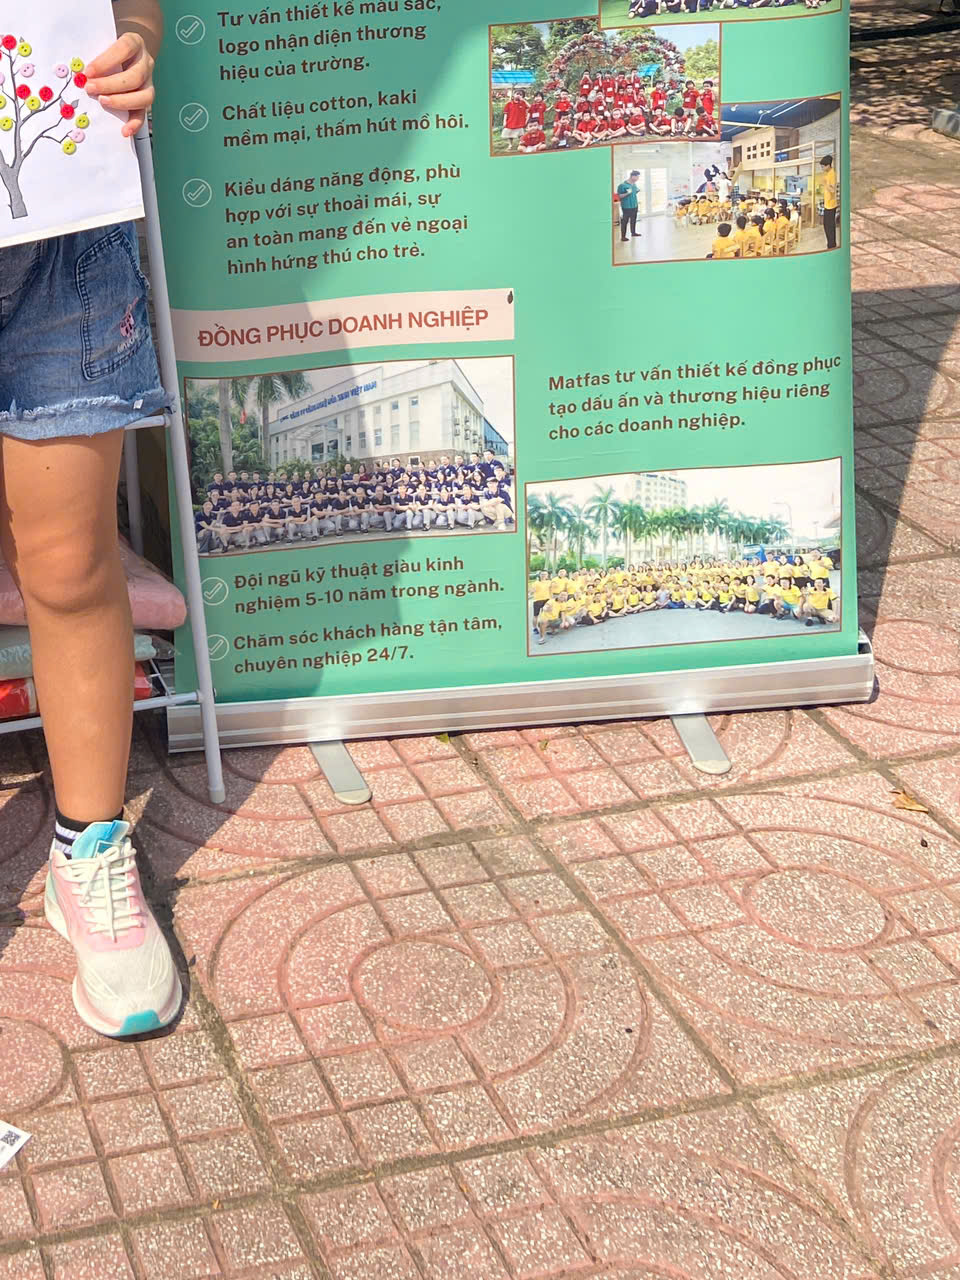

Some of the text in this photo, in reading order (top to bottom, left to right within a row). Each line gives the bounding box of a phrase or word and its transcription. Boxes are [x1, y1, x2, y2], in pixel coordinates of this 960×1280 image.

[217, 11, 244, 27] Tư
[248, 6, 281, 25] vấn
[285, 1, 329, 22] thiết
[219, 21, 427, 56] logo nhận diện thương
[197, 305, 488, 347] ĐỒNG PHỤC DOANH NGHIỆP
[549, 356, 841, 391] Matfas tư vấn thiết kế đồng phục
[548, 383, 830, 418] tạo dấu ấn và thương hiệu riêng
[549, 413, 745, 440] cho các doanh nghiệp.
[234, 556, 464, 590] Đội ngũ kỹ thuật giàu kinh
[235, 578, 504, 615] nghiệm 5-10 năm trong ngành.
[233, 617, 502, 650] Chăm sóc khách hàng tận tâm,
